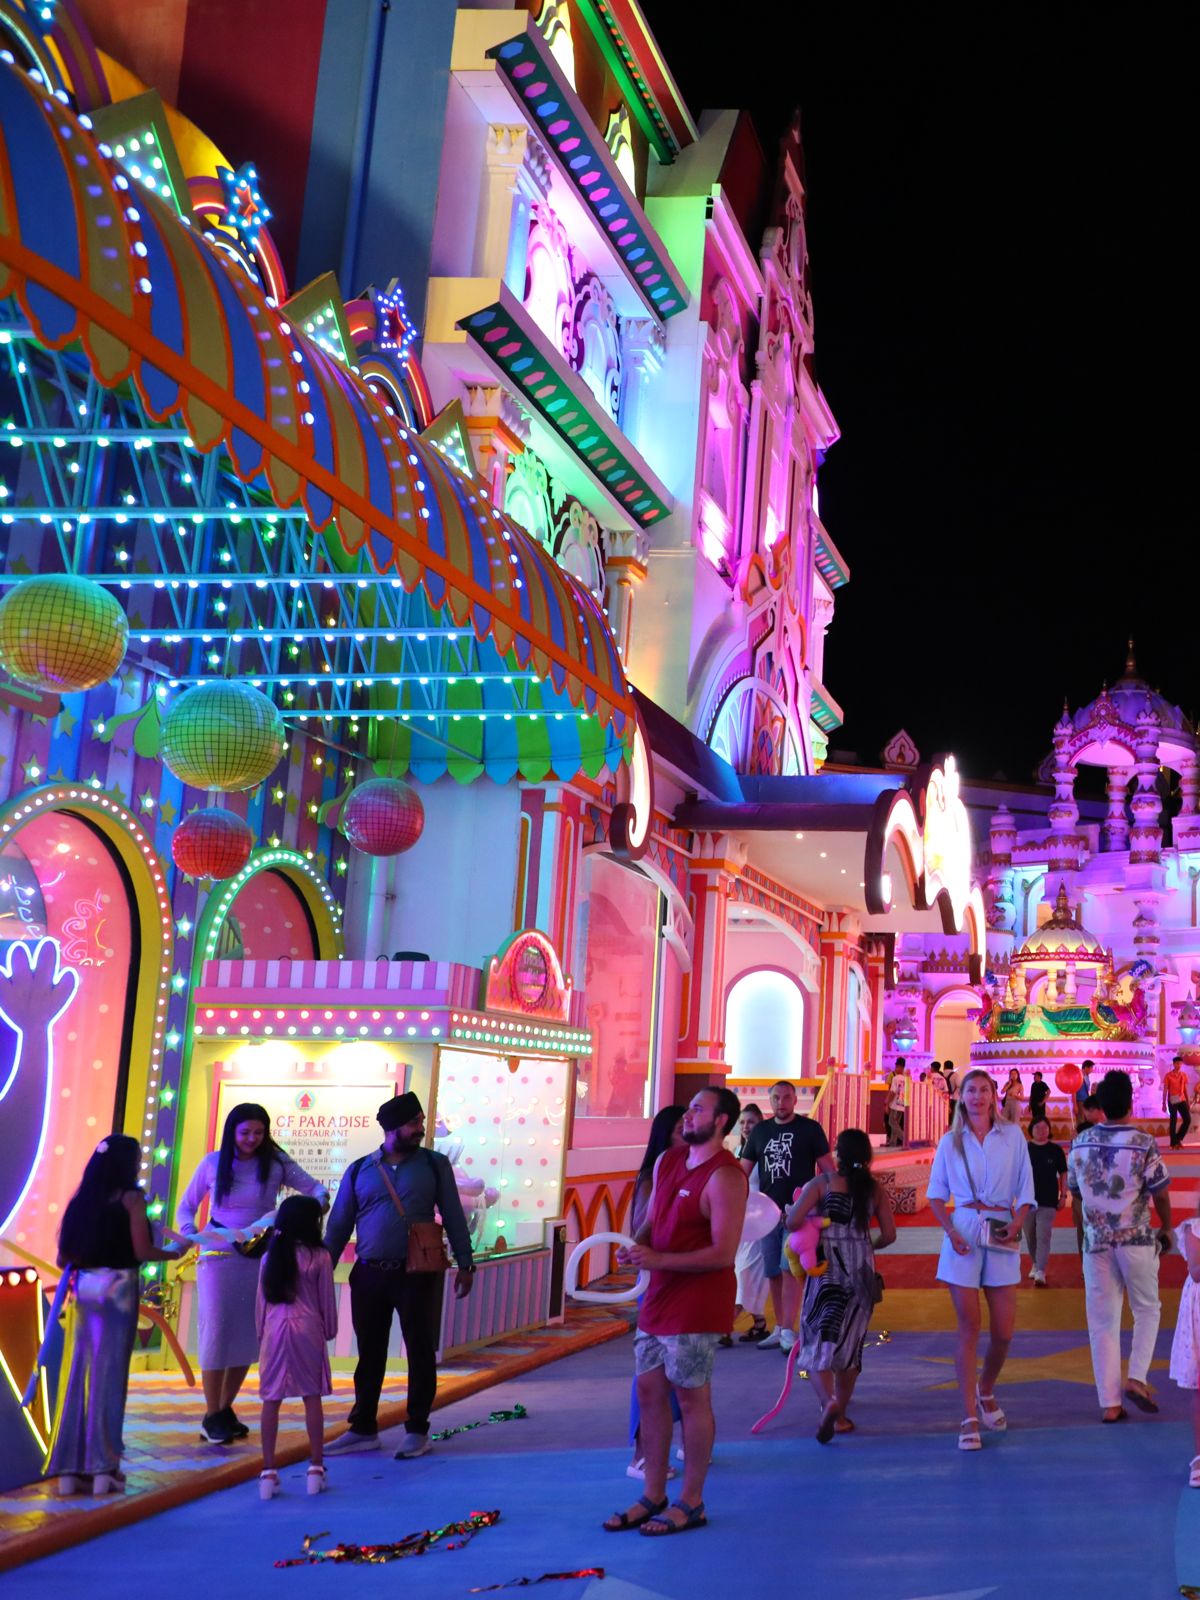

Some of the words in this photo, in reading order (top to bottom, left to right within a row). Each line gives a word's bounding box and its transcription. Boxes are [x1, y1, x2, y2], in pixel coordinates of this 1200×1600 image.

[276, 1115, 295, 1128] OF
[299, 1115, 370, 1128] PARADISE
[292, 1129, 349, 1137] RESTAURANT
